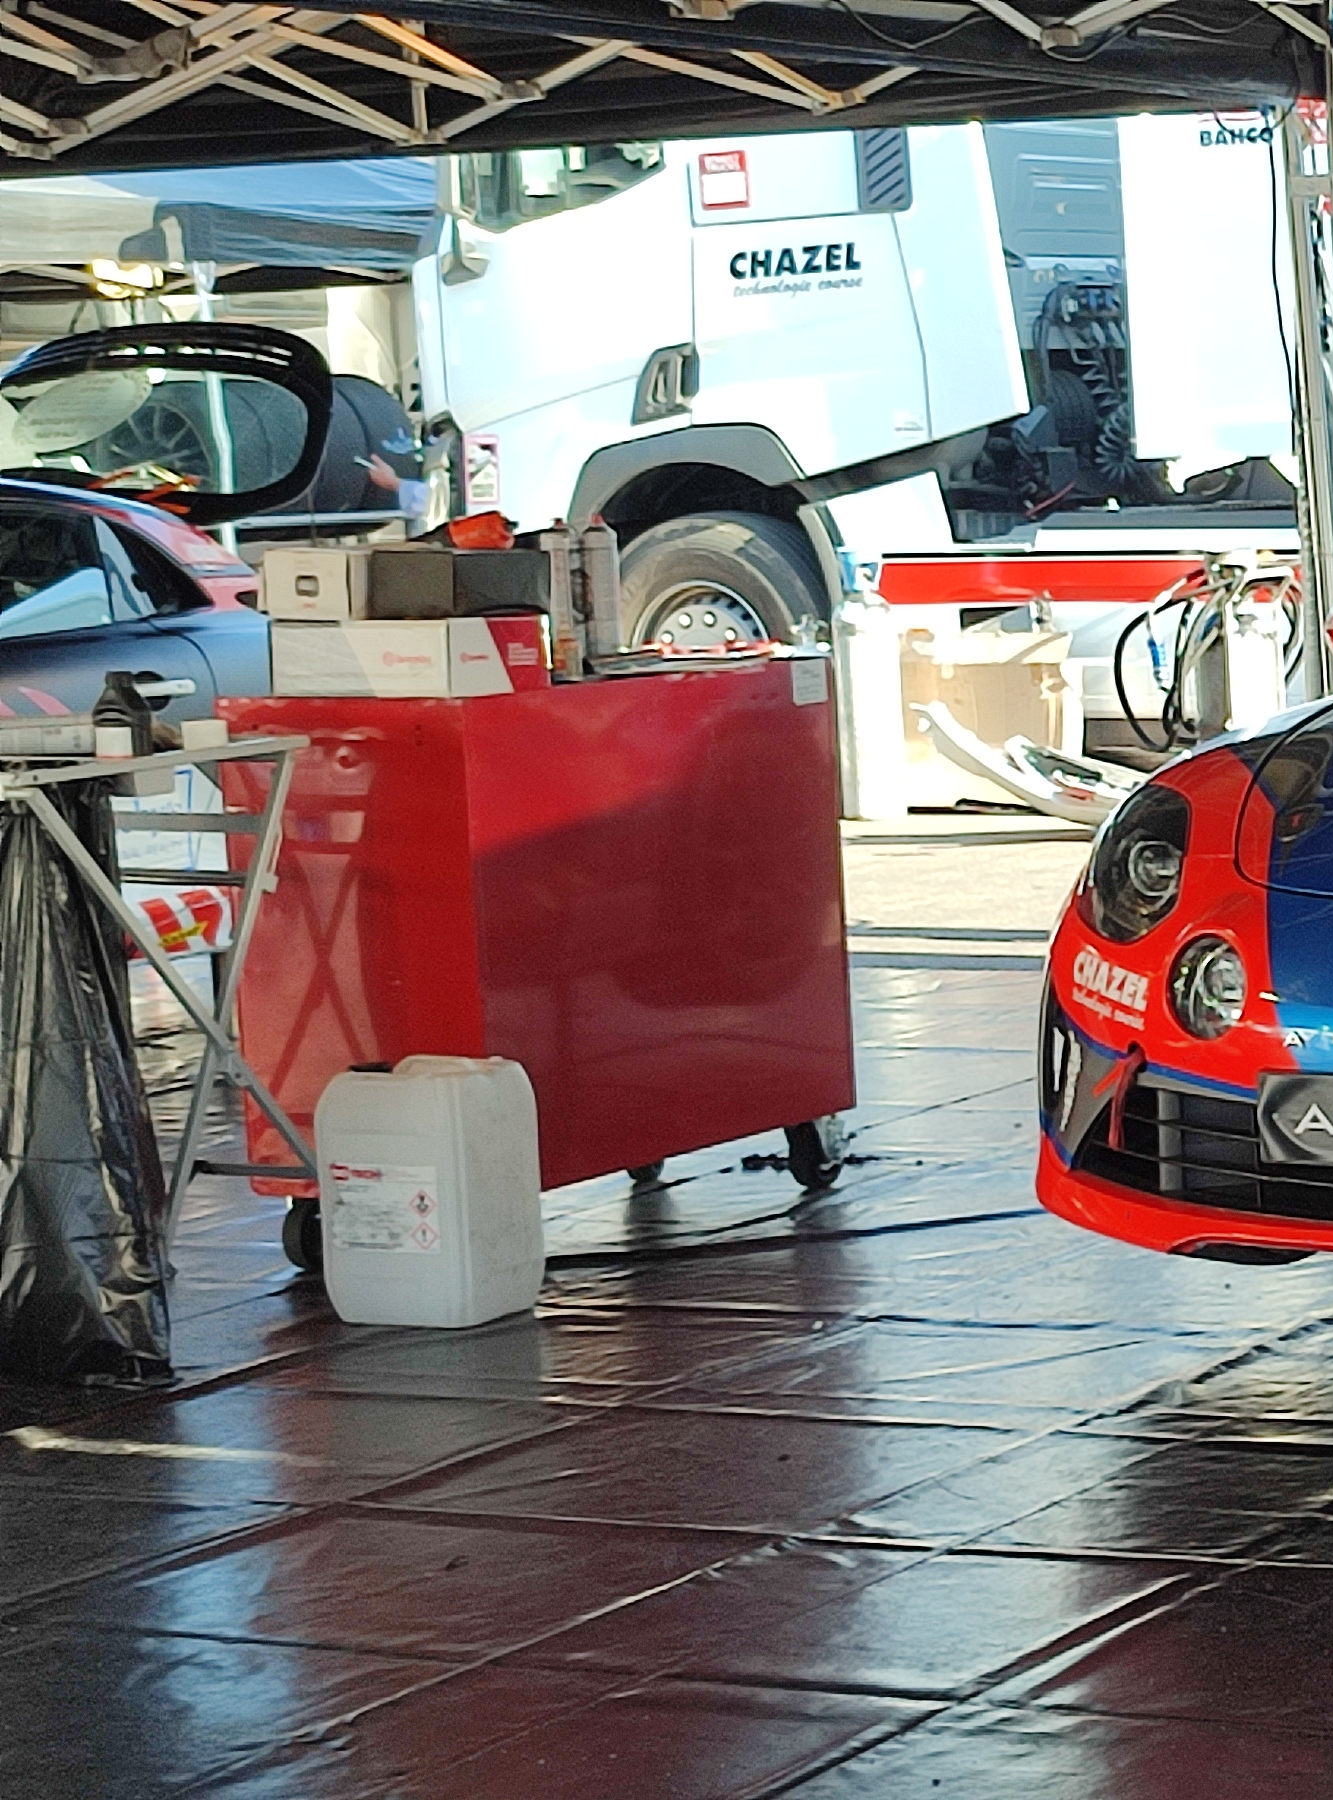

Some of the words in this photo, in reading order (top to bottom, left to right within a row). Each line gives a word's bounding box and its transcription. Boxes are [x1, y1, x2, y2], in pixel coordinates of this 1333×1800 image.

[1200, 127, 1273, 147] BAHCO
[729, 242, 862, 280] CHAZEL
[1073, 950, 1150, 1012] CHAZEL
